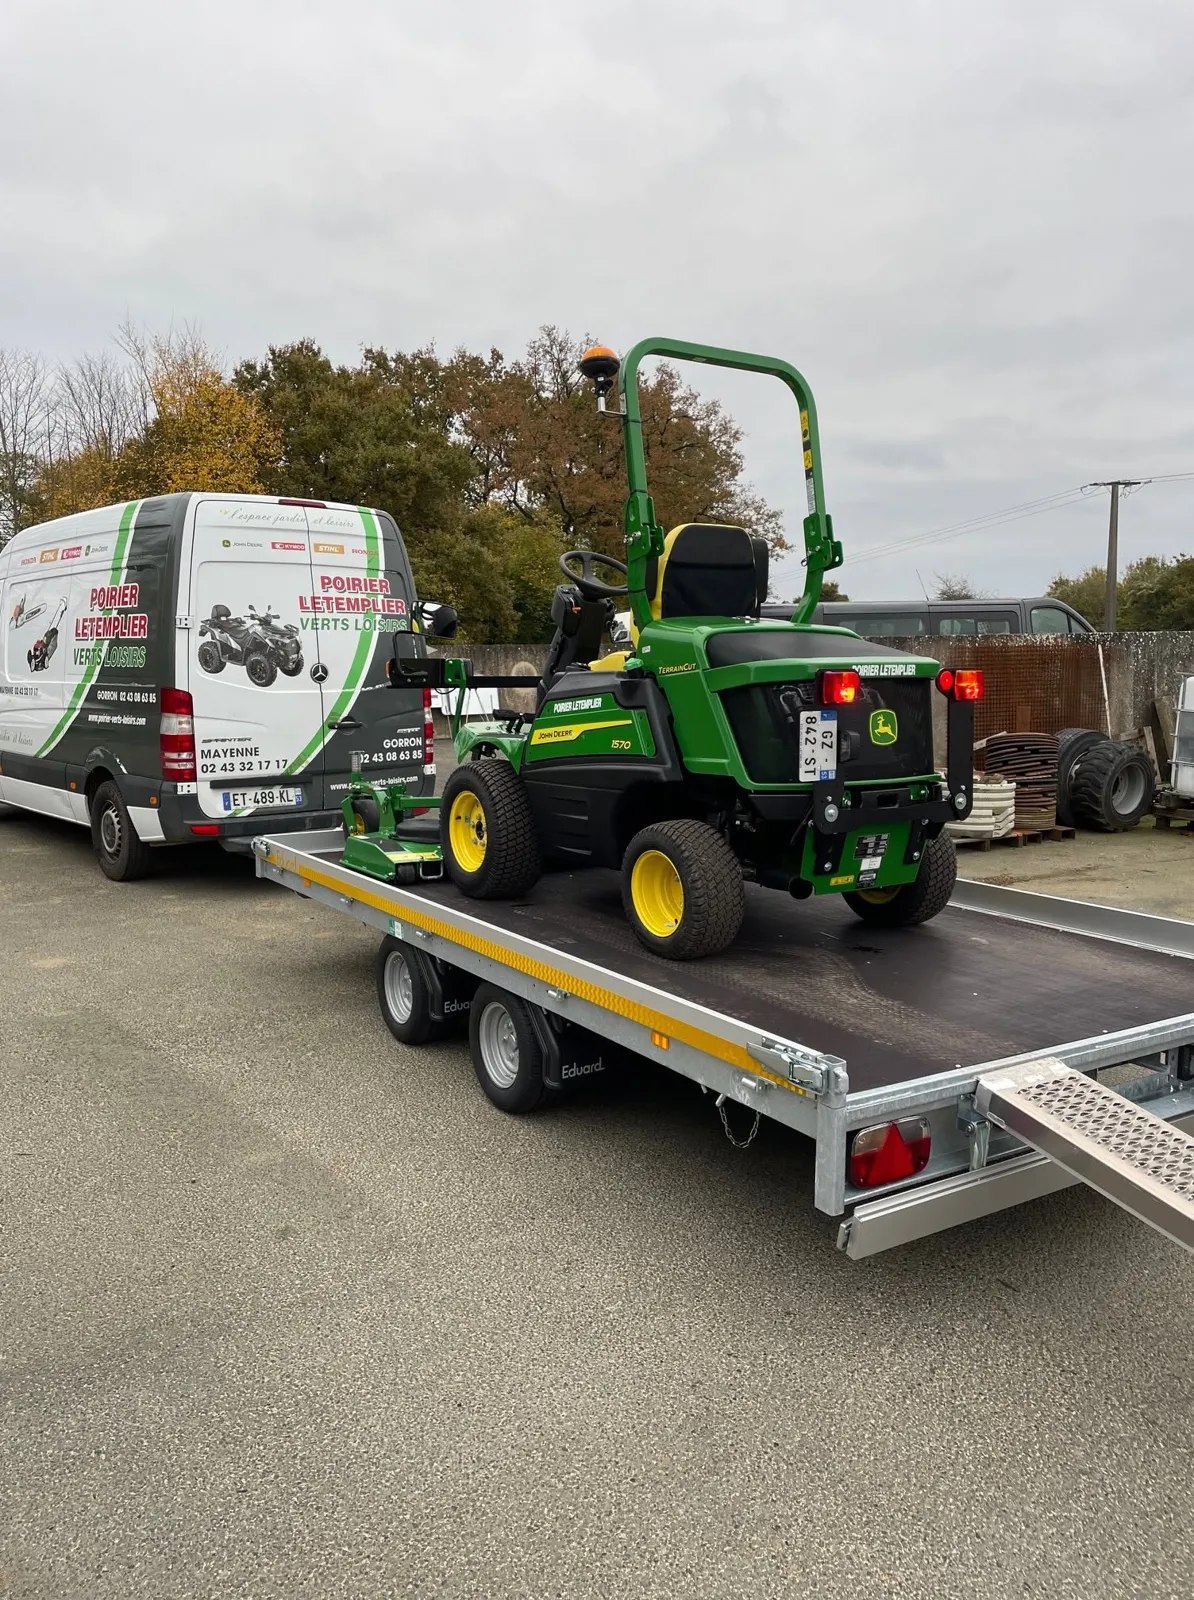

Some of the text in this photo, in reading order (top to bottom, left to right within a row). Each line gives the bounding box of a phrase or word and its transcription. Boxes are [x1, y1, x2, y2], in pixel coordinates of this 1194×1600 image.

[318, 545, 339, 553] STIHL
[320, 575, 391, 594] POIRIER
[89, 583, 139, 611] POIRIER
[298, 595, 406, 614] LETEMPLIER
[74, 613, 148, 641] LETEMPLIER
[300, 618, 408, 632] VERTS LOISIRS
[73, 646, 147, 667] VERTS LOISIRS
[879, 664, 916, 676] LETEMPLIER
[97, 690, 118, 700] GORRON
[119, 691, 126, 701] 02
[127, 691, 133, 702] 43
[141, 692, 148, 703] 63
[149, 693, 156, 703] 85
[553, 698, 602, 713] POIRIER LETEMPLIER
[383, 737, 422, 748] GORRON
[611, 740, 631, 750] 1570
[804, 716, 817, 776] 842-ST
[200, 747, 260, 759] MAYENNE
[372, 752, 384, 762] 43
[386, 751, 397, 761] 08
[400, 750, 410, 760] 63
[412, 750, 423, 759] 85
[201, 759, 288, 773] 02 43 32 17 17
[232, 789, 293, 807] ET-489-KL
[444, 999, 473, 1014] Eduar
